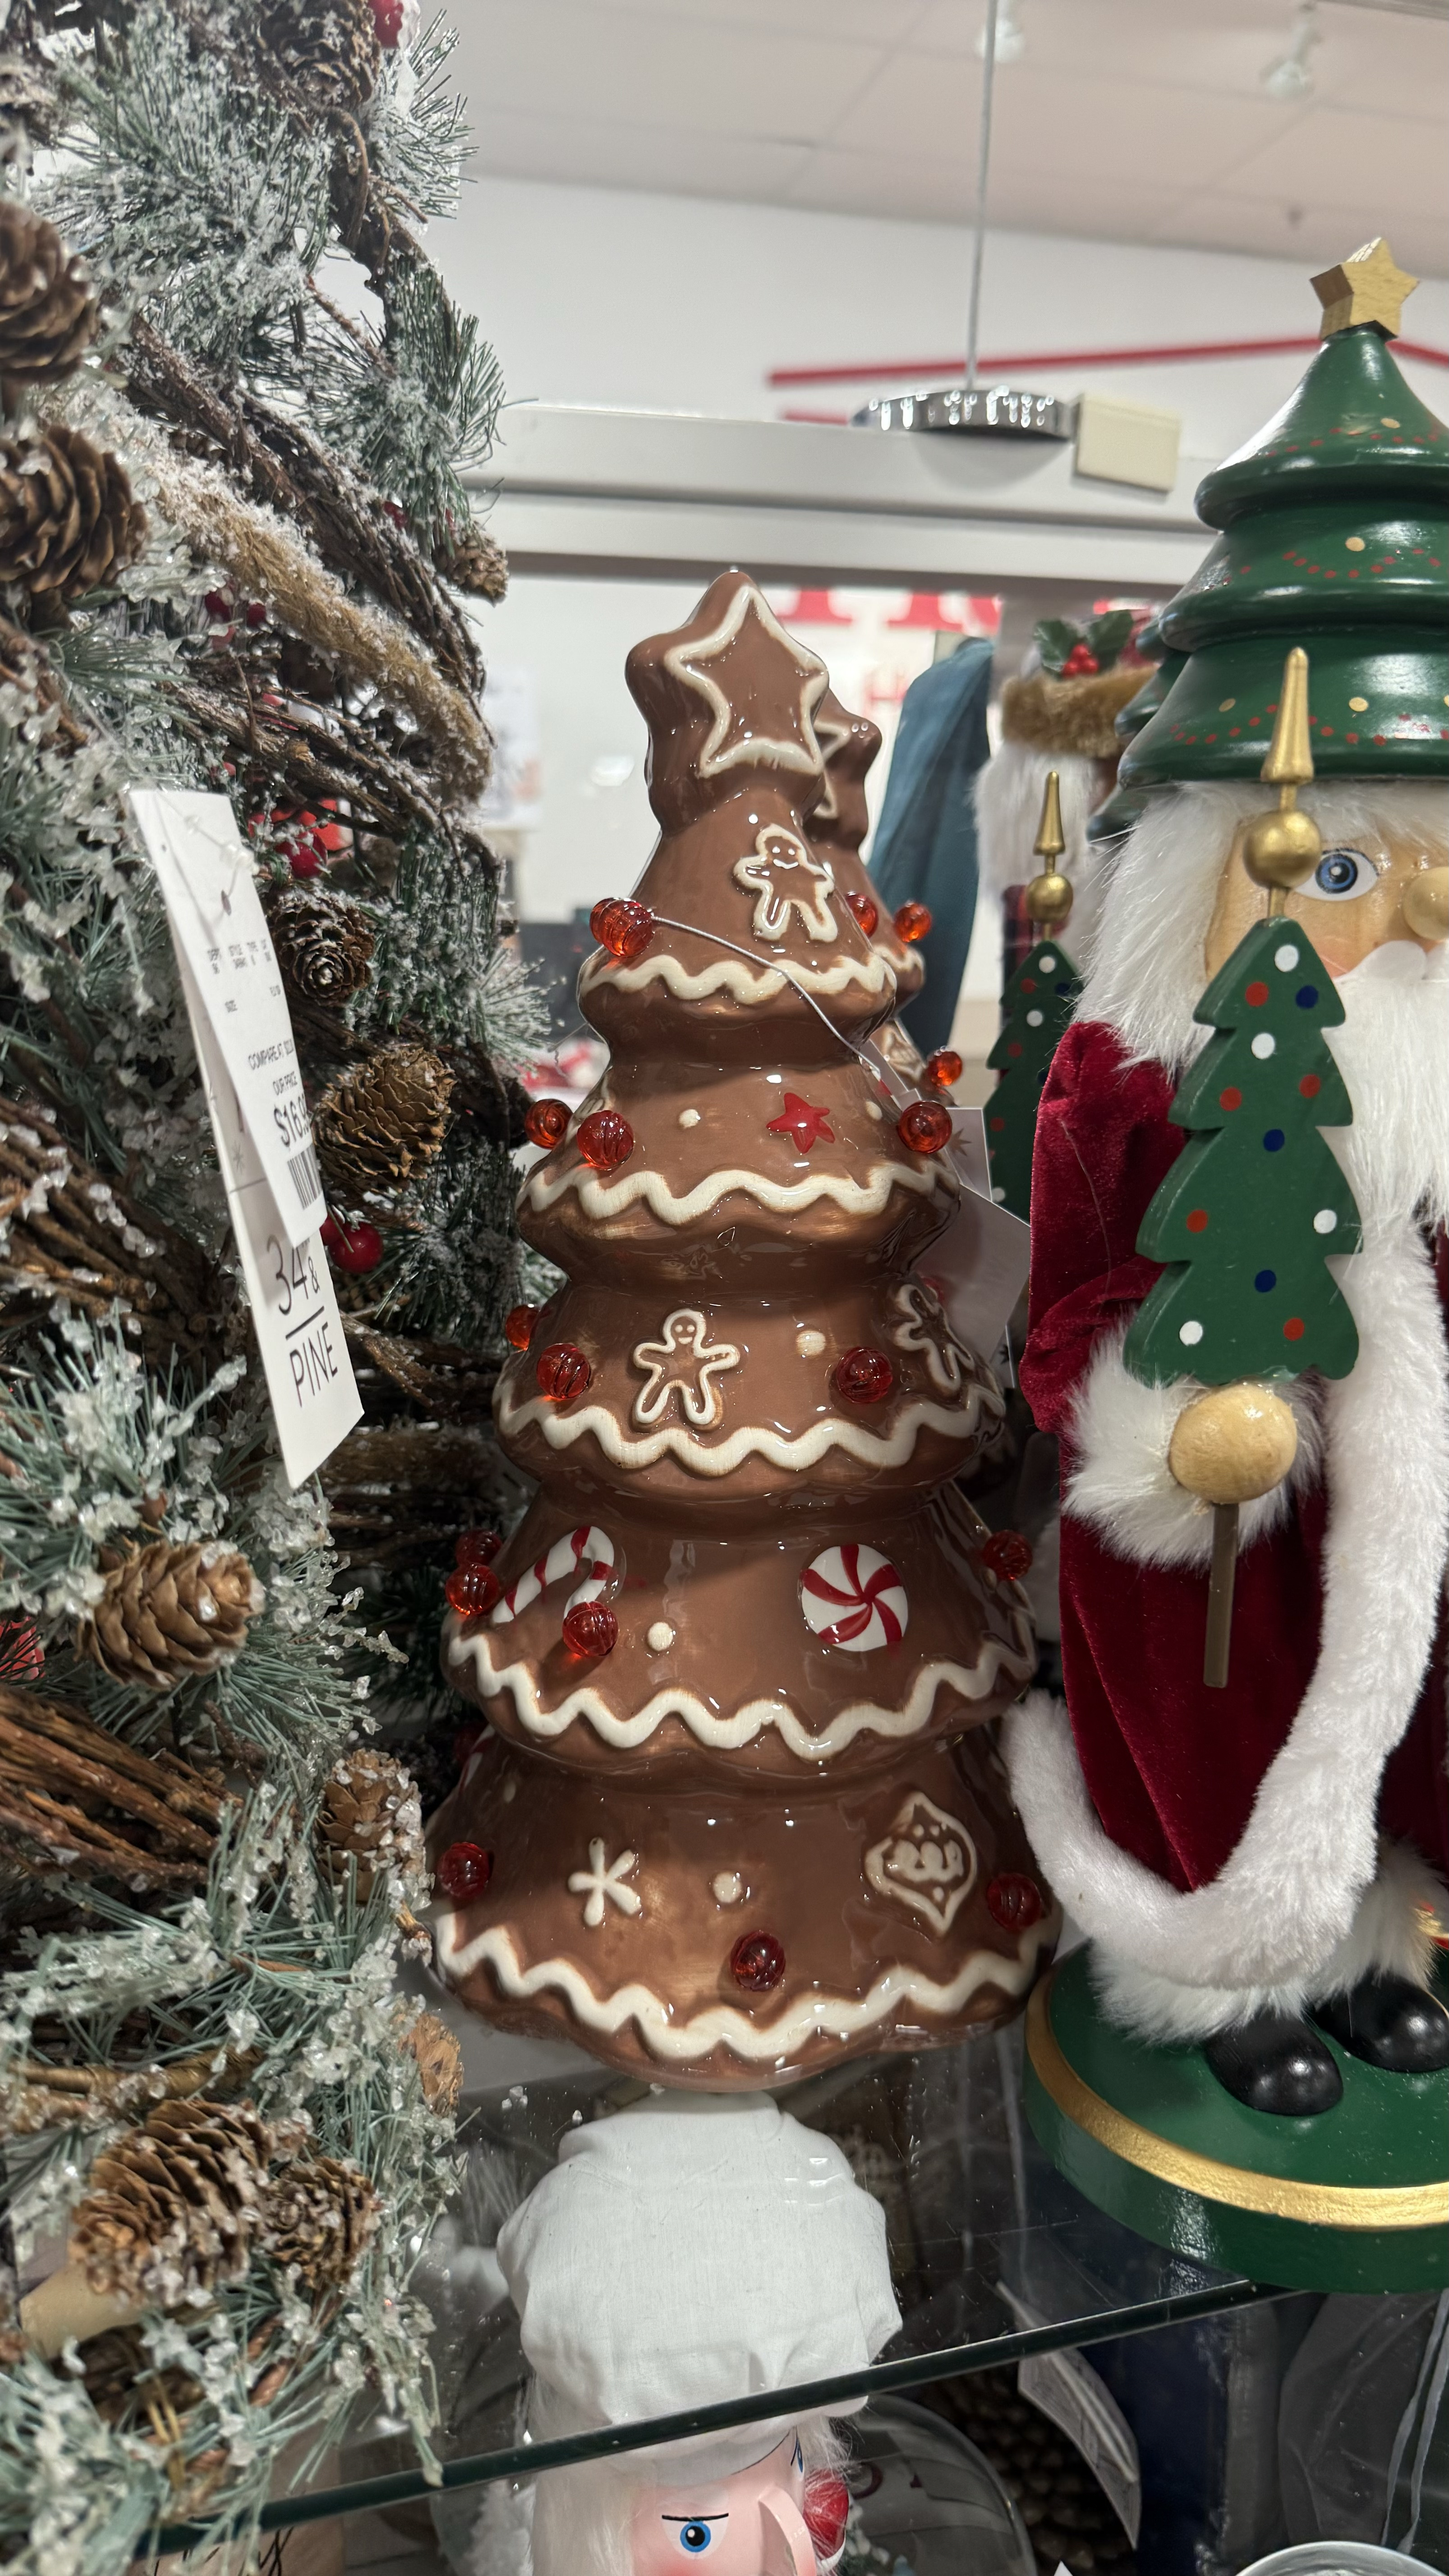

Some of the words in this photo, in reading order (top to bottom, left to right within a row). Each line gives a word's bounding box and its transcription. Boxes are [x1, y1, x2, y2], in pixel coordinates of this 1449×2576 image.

[248, 1045, 279, 1071] COMPARE
[308, 1256, 321, 1294] &
[290, 1321, 338, 1408] PINE
